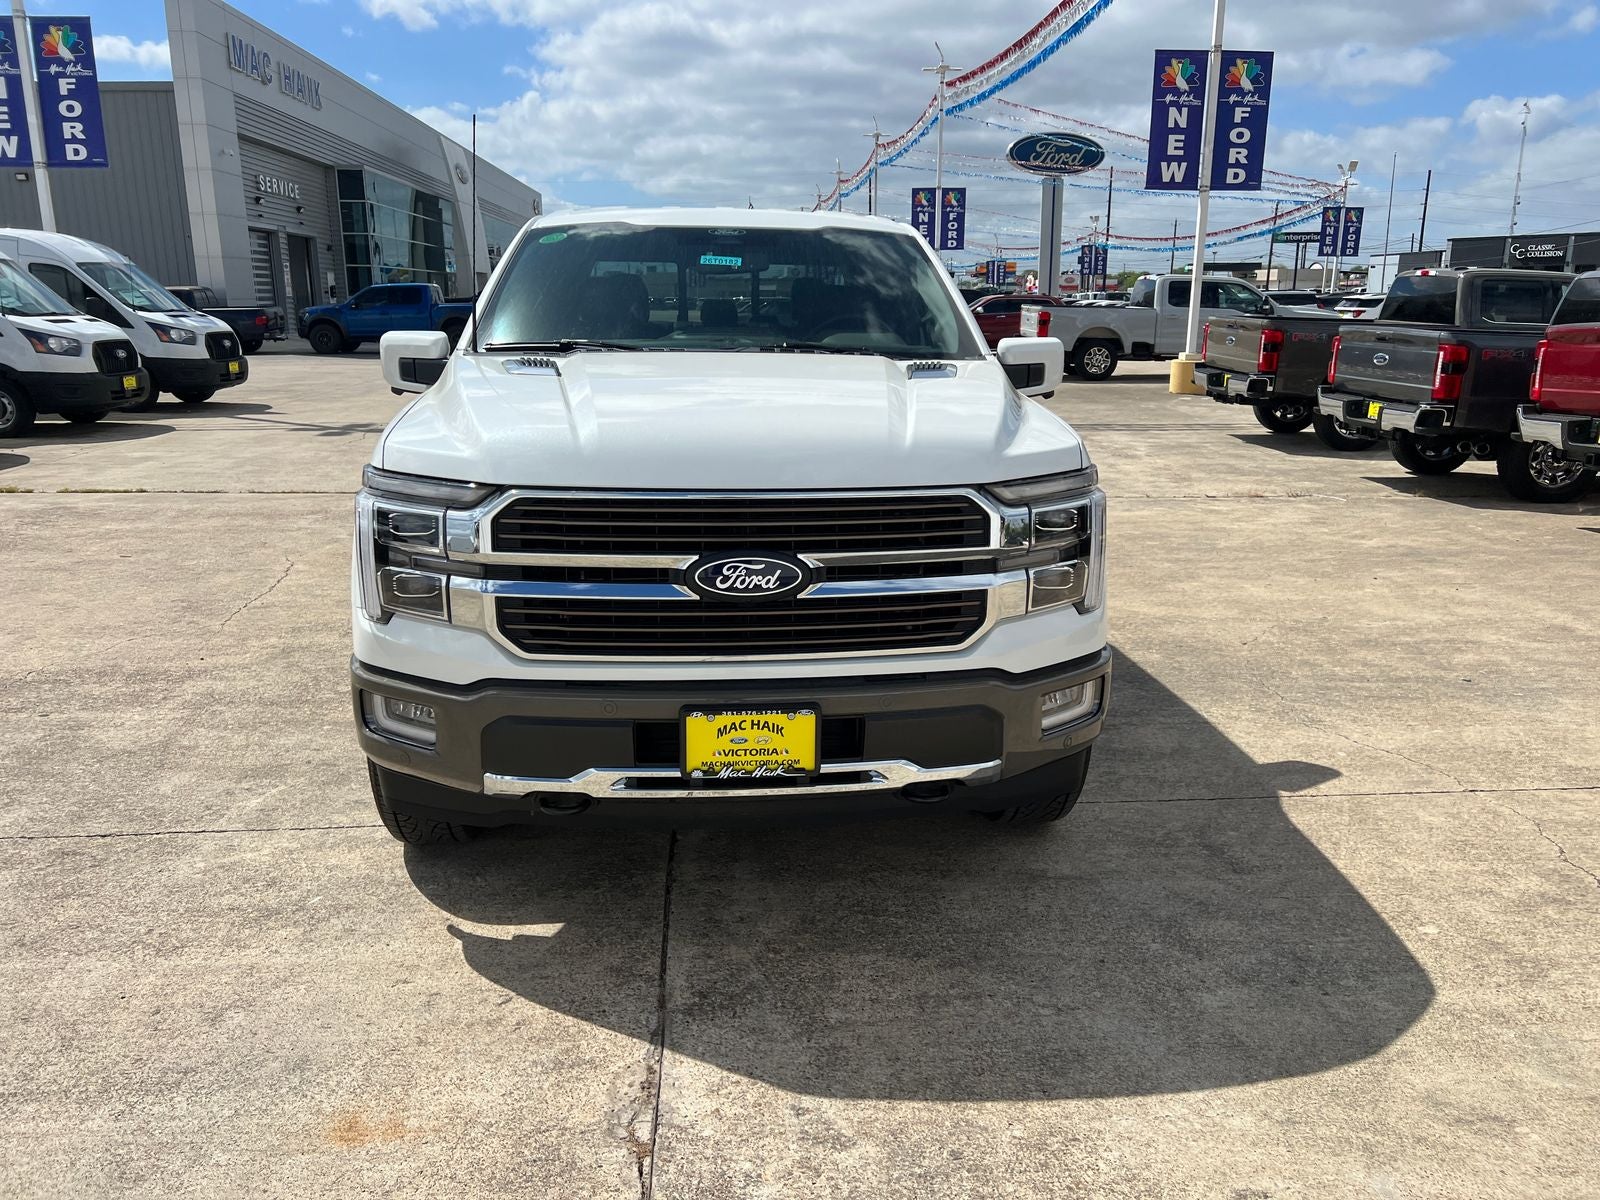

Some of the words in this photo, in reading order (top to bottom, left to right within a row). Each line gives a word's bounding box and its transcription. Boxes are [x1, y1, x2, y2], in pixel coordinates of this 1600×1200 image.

[226, 32, 273, 86] MAC
[278, 61, 322, 111] HAIK
[58, 78, 88, 161] FORD
[1030, 140, 1087, 166] Ford
[1160, 107, 1188, 183] NEW
[1225, 107, 1251, 184] FORD
[258, 174, 300, 199] SERVICE
[919, 212, 930, 241] NE
[947, 212, 958, 248] FORD
[1323, 226, 1335, 255] NEW
[1345, 227, 1357, 255] FORD
[1527, 250, 1564, 258] COLLISION
[703, 257, 739, 266] 26T0182
[715, 562, 781, 589] Ford
[716, 719, 747, 738] MAC
[750, 719, 785, 738] HAIK
[701, 759, 801, 768] MACHAIKVICTORIA.COM
[722, 748, 779, 757] VICTORIA
[716, 766, 750, 779] Mac
[751, 764, 787, 778] Haik
